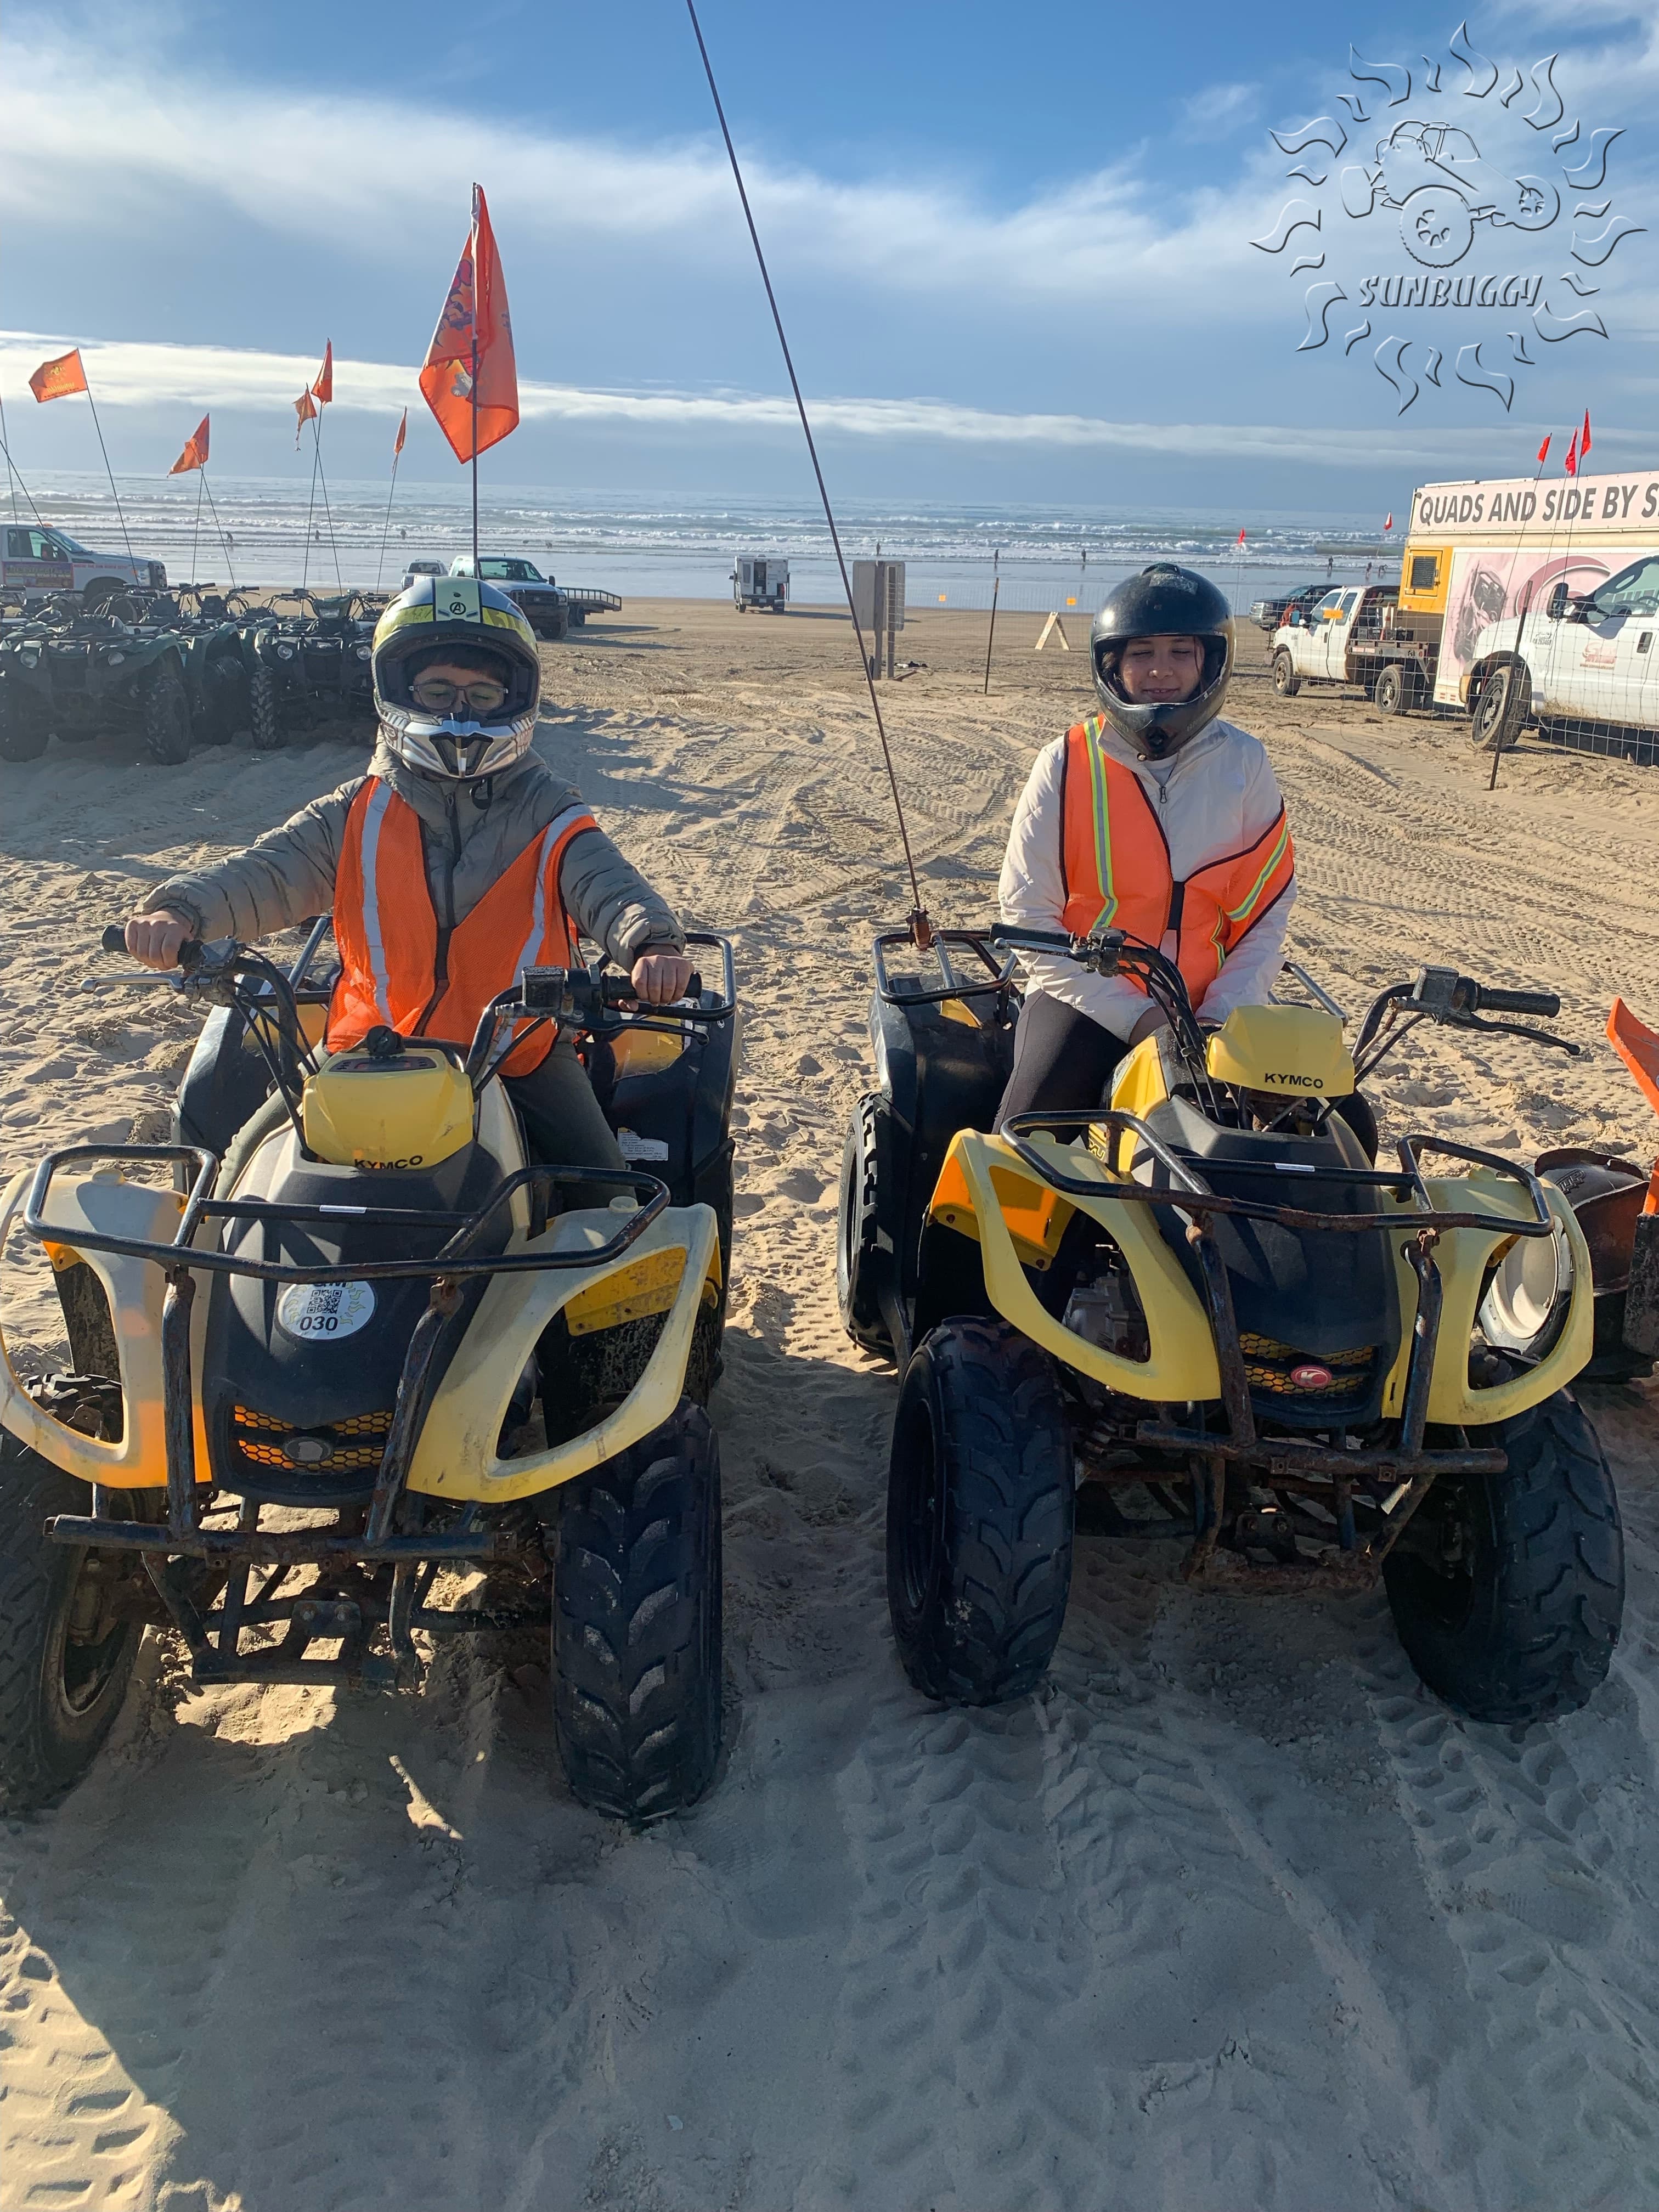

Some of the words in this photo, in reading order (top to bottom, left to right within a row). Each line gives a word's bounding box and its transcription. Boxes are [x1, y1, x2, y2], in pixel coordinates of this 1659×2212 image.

[1420, 493, 1485, 526] QUADS
[1488, 492, 1537, 522] AND
[1542, 487, 1596, 521] SIDE
[1602, 485, 1639, 518] BY
[1641, 483, 1659, 518] S
[1265, 1073, 1323, 1088] KYMCO
[354, 1155, 423, 1170] KYMCO
[300, 1316, 338, 1331] 030
